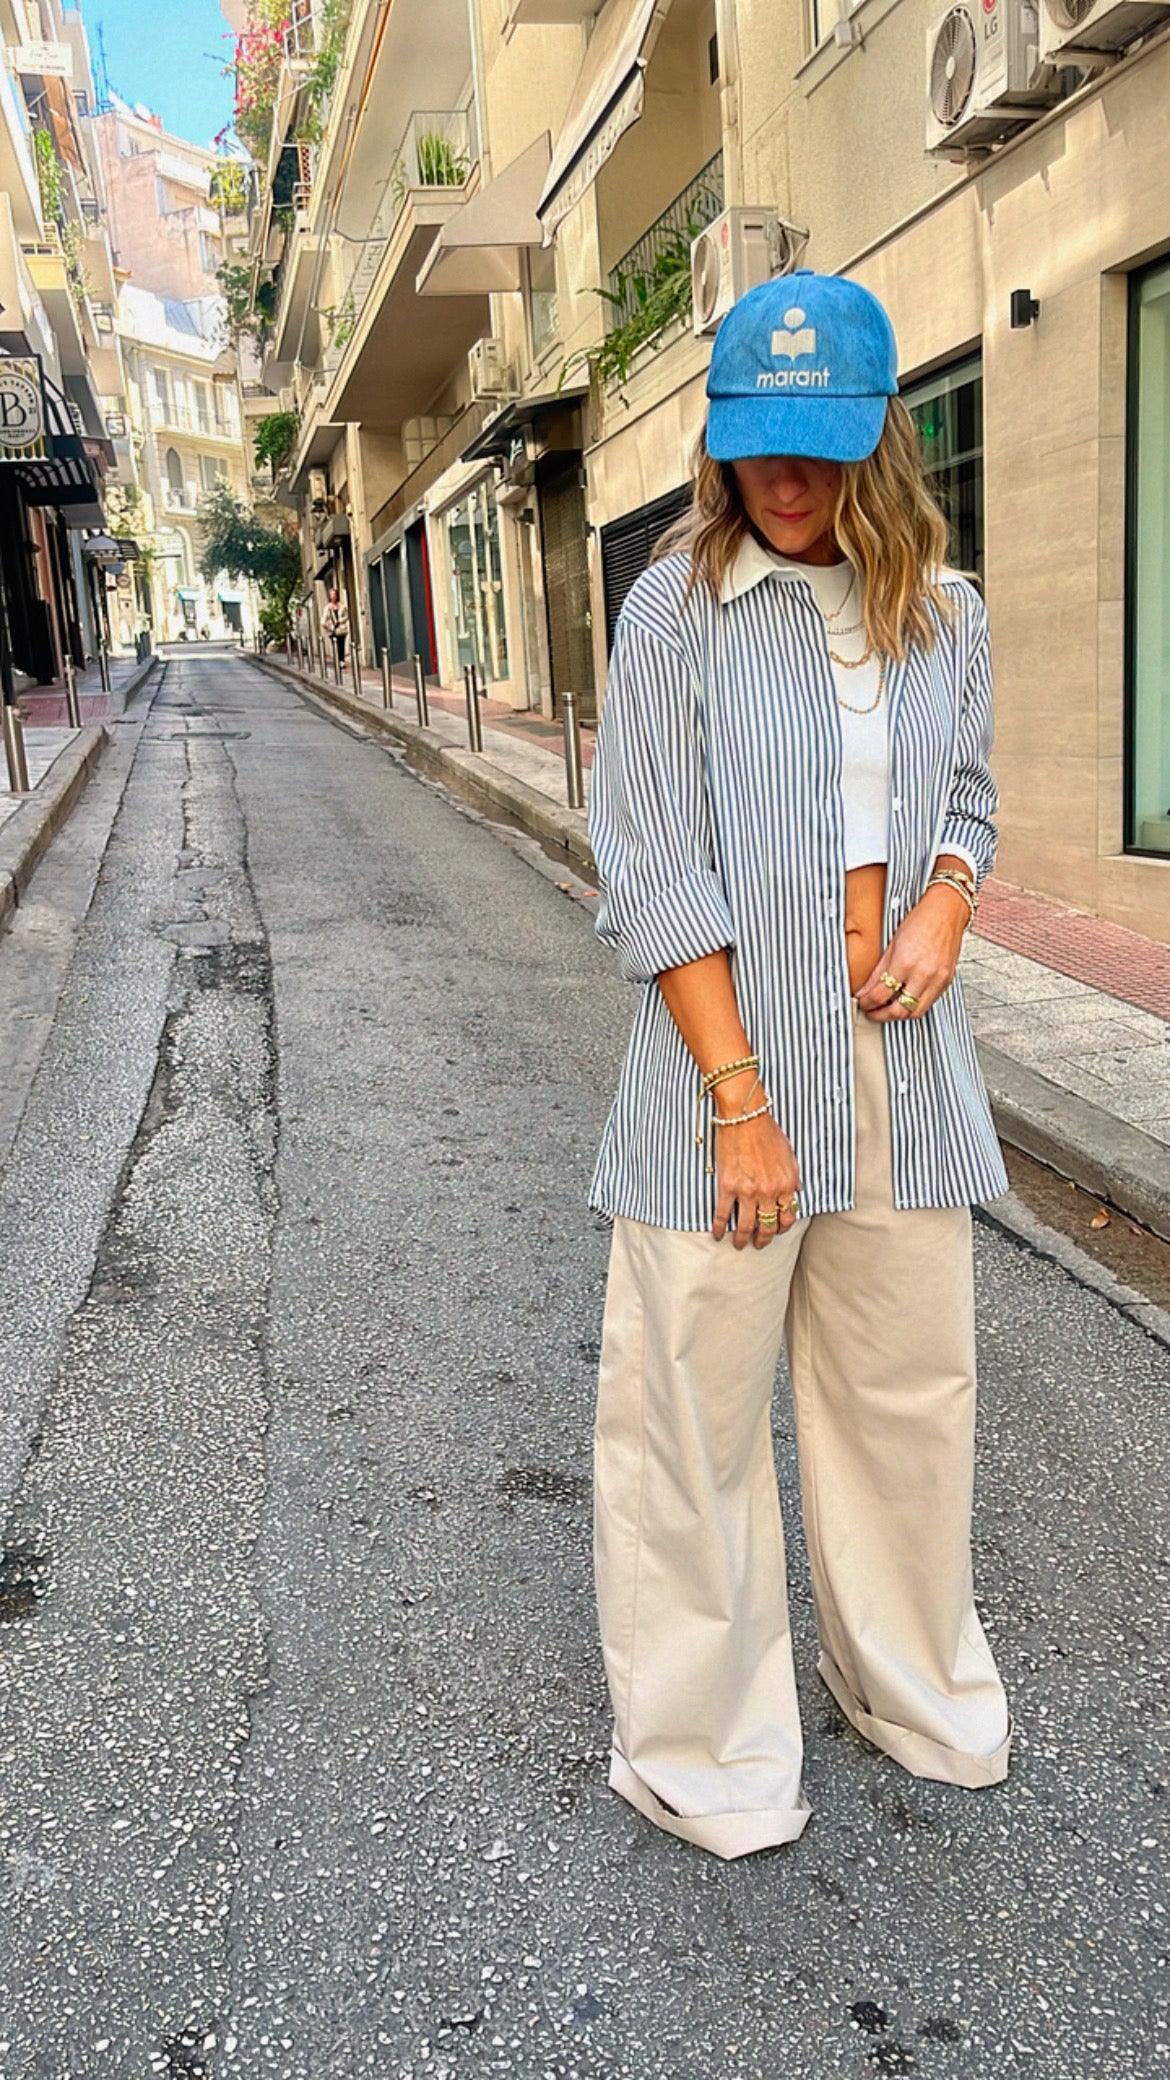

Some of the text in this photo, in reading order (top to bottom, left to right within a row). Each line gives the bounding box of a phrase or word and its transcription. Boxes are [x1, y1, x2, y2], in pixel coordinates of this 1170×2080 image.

[984, 15, 999, 40] LG
[756, 366, 830, 389] marant
[0, 391, 27, 427] B
